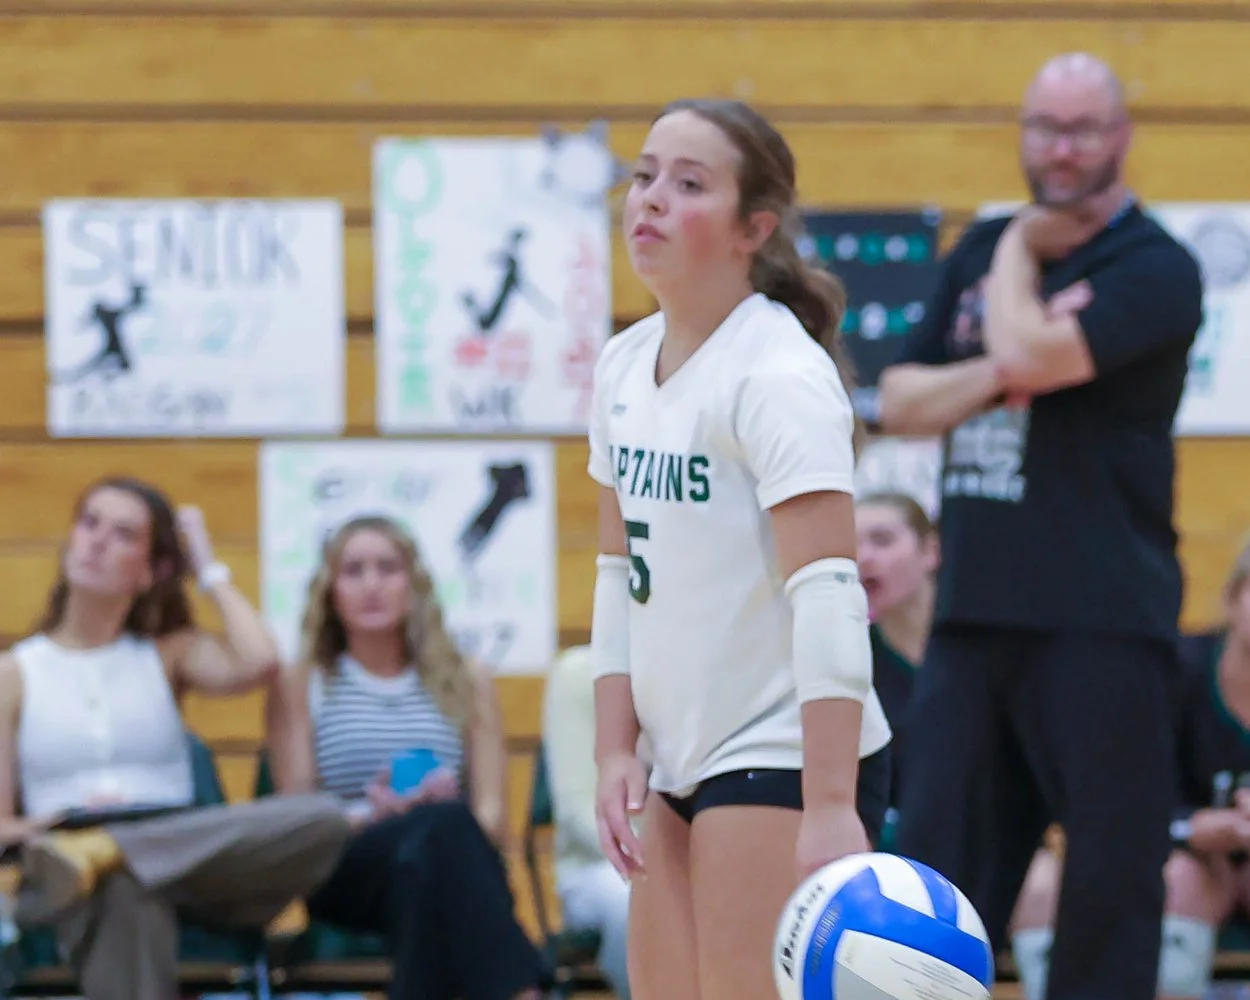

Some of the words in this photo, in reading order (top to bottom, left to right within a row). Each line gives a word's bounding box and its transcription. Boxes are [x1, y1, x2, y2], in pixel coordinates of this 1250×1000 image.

[66, 206, 303, 288] SENIOR
[609, 444, 710, 502] PTAINS
[623, 519, 652, 605] 5
